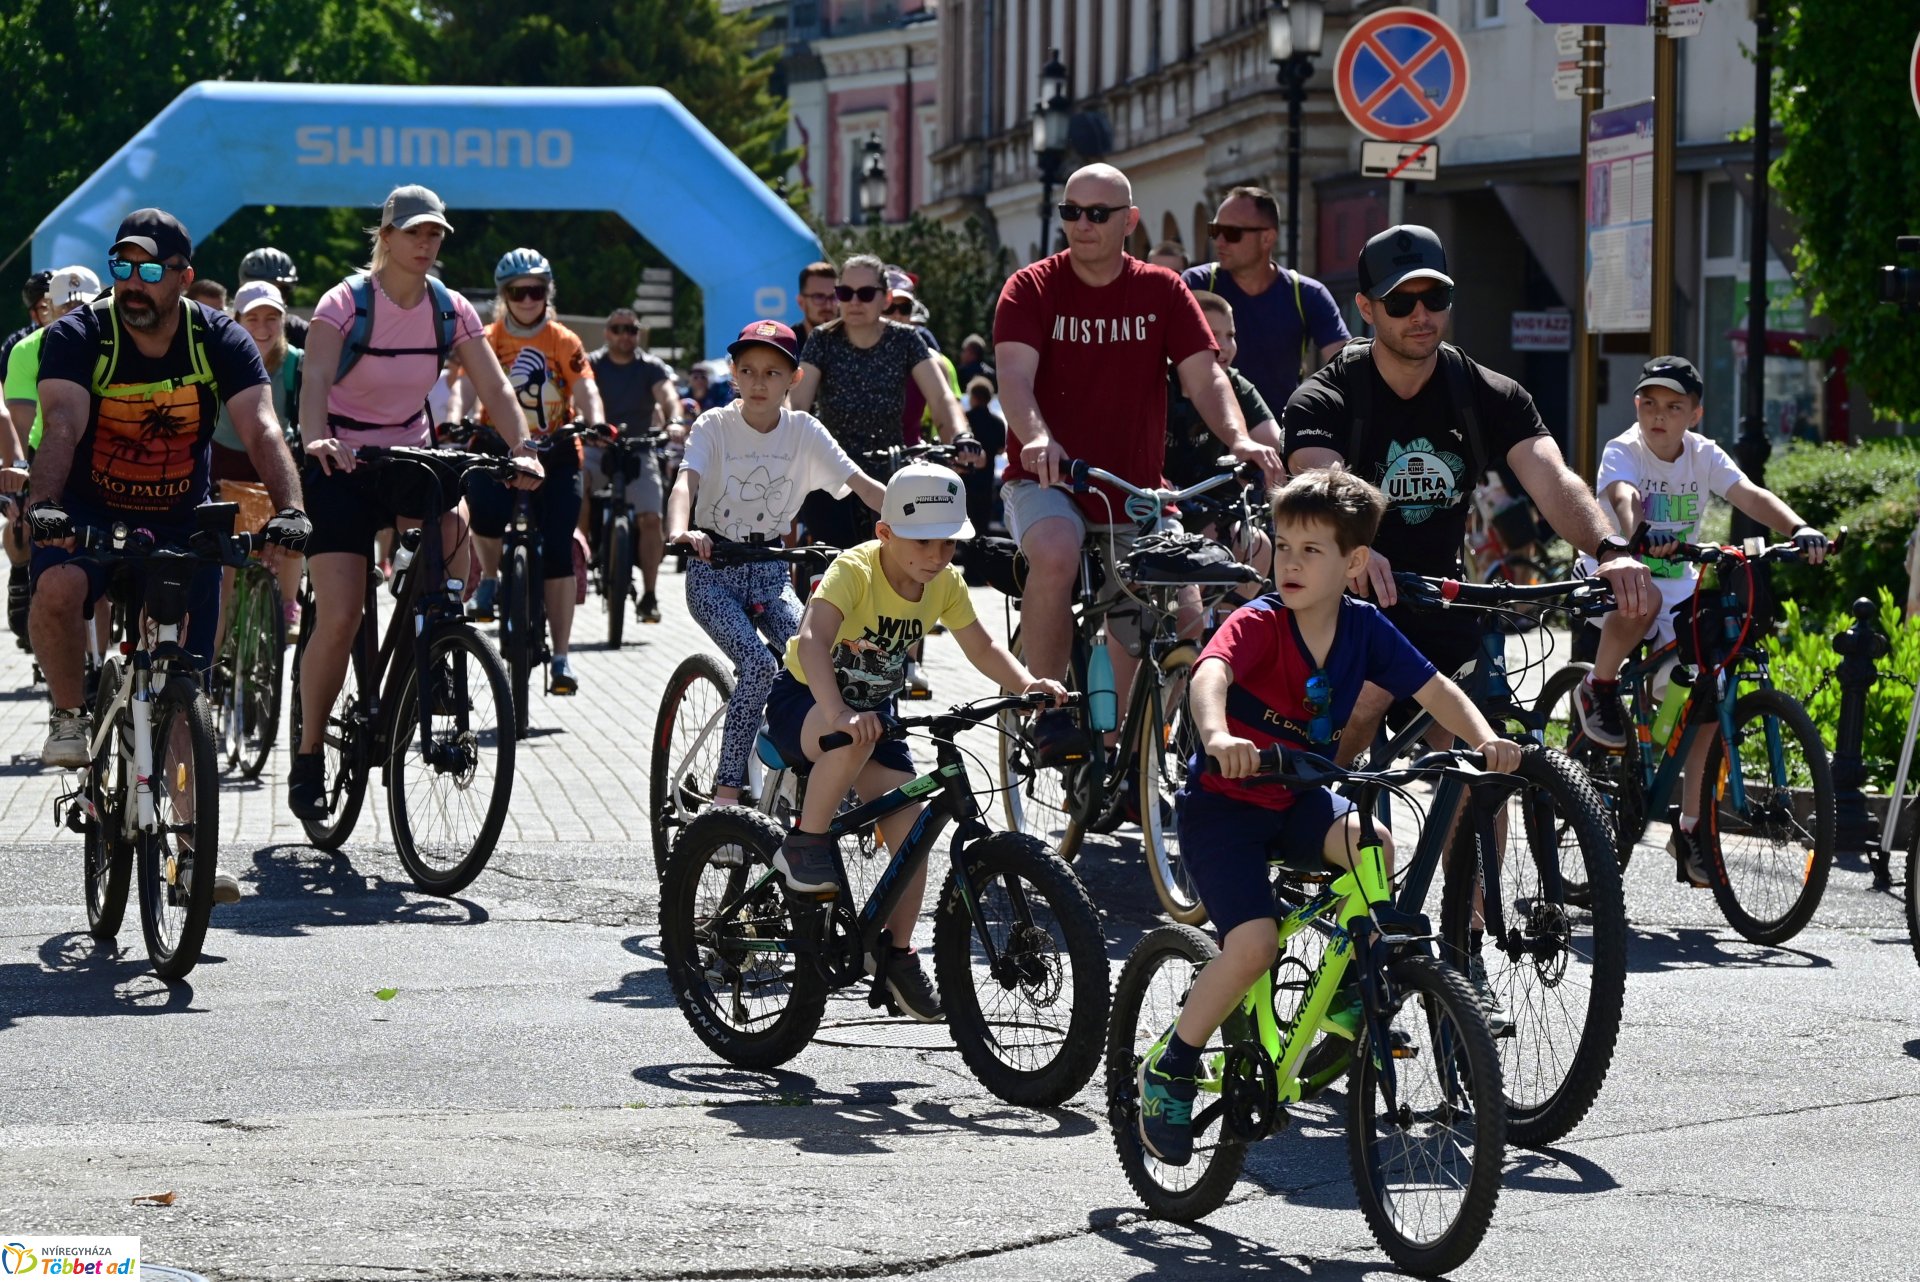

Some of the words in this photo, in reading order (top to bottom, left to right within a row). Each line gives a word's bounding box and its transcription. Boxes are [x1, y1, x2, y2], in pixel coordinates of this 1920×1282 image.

[295, 125, 573, 168] SHIMANO
[91, 469, 126, 493] SÃO
[130, 478, 191, 497] PAULO
[1389, 477, 1447, 497] ULTRA
[878, 615, 923, 640] WILD
[1263, 708, 1280, 725] FC
[946, 860, 986, 915] KEDA
[683, 980, 731, 1045] KENDA
